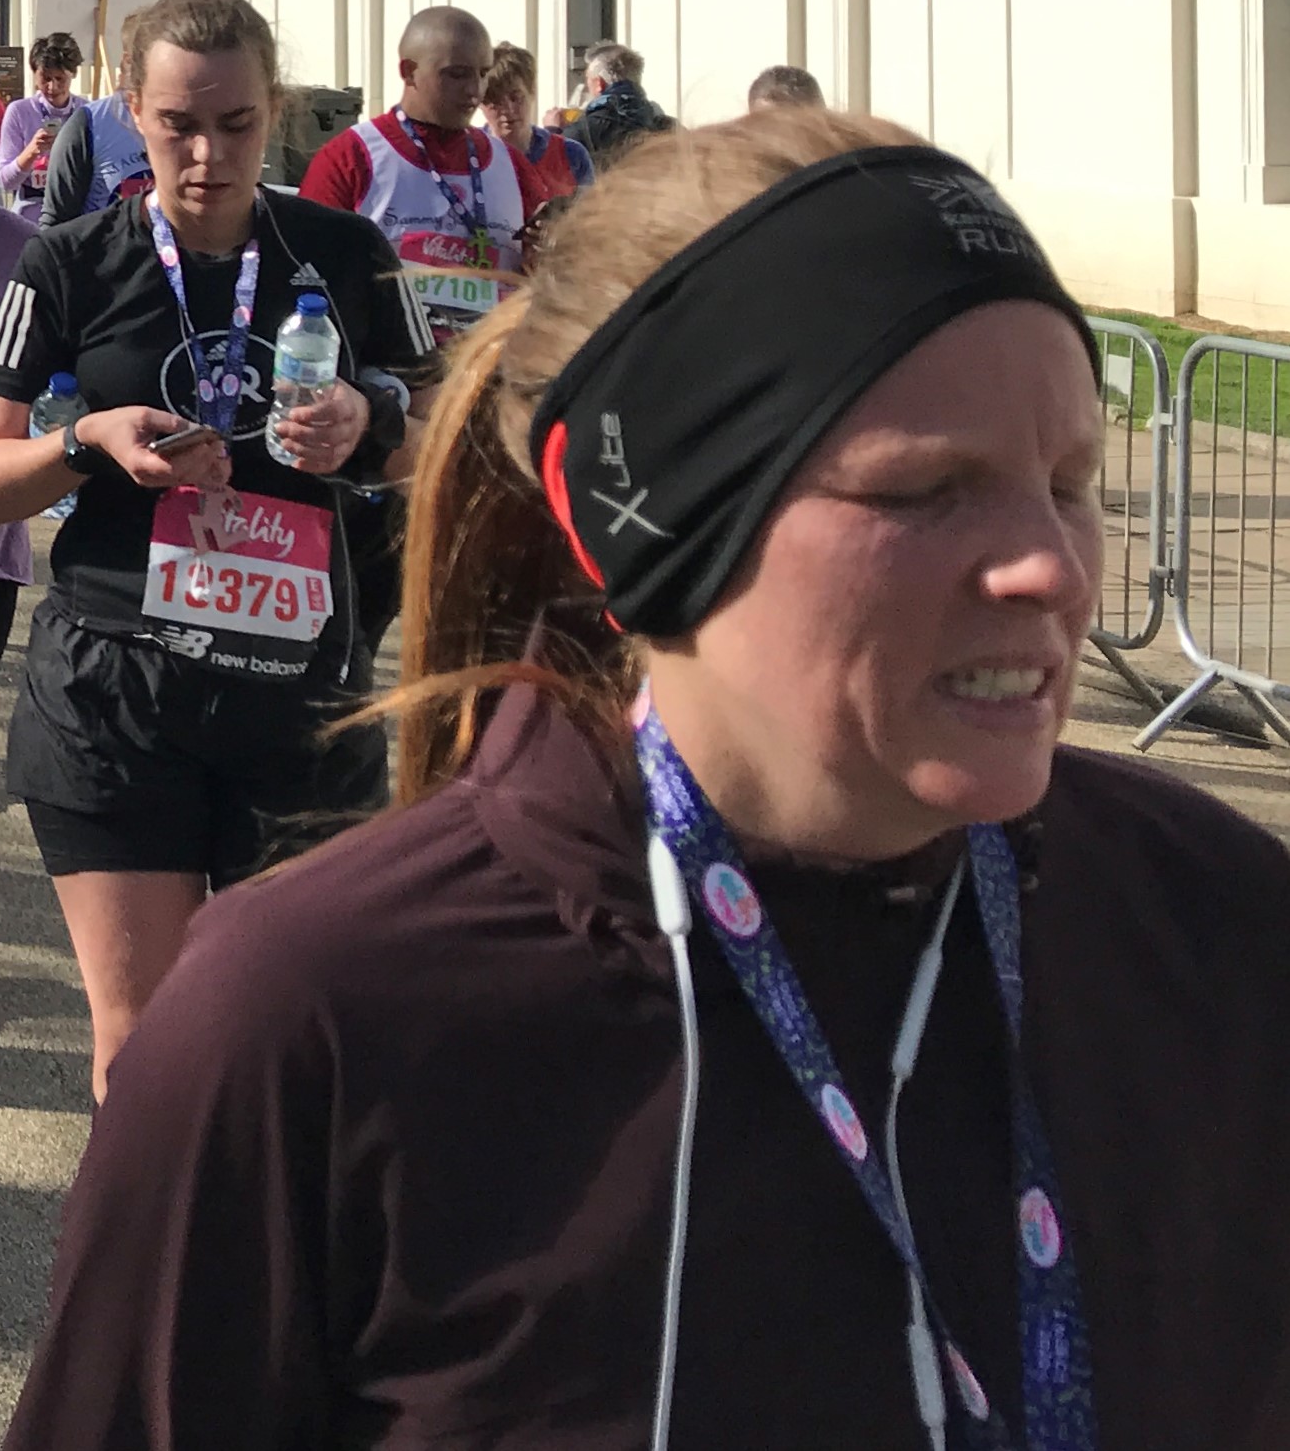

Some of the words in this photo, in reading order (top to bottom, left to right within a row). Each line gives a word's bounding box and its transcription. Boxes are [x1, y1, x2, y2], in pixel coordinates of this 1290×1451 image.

[422, 235, 471, 264] Vitalit
[223, 505, 295, 559] tality
[210, 651, 248, 670] new
